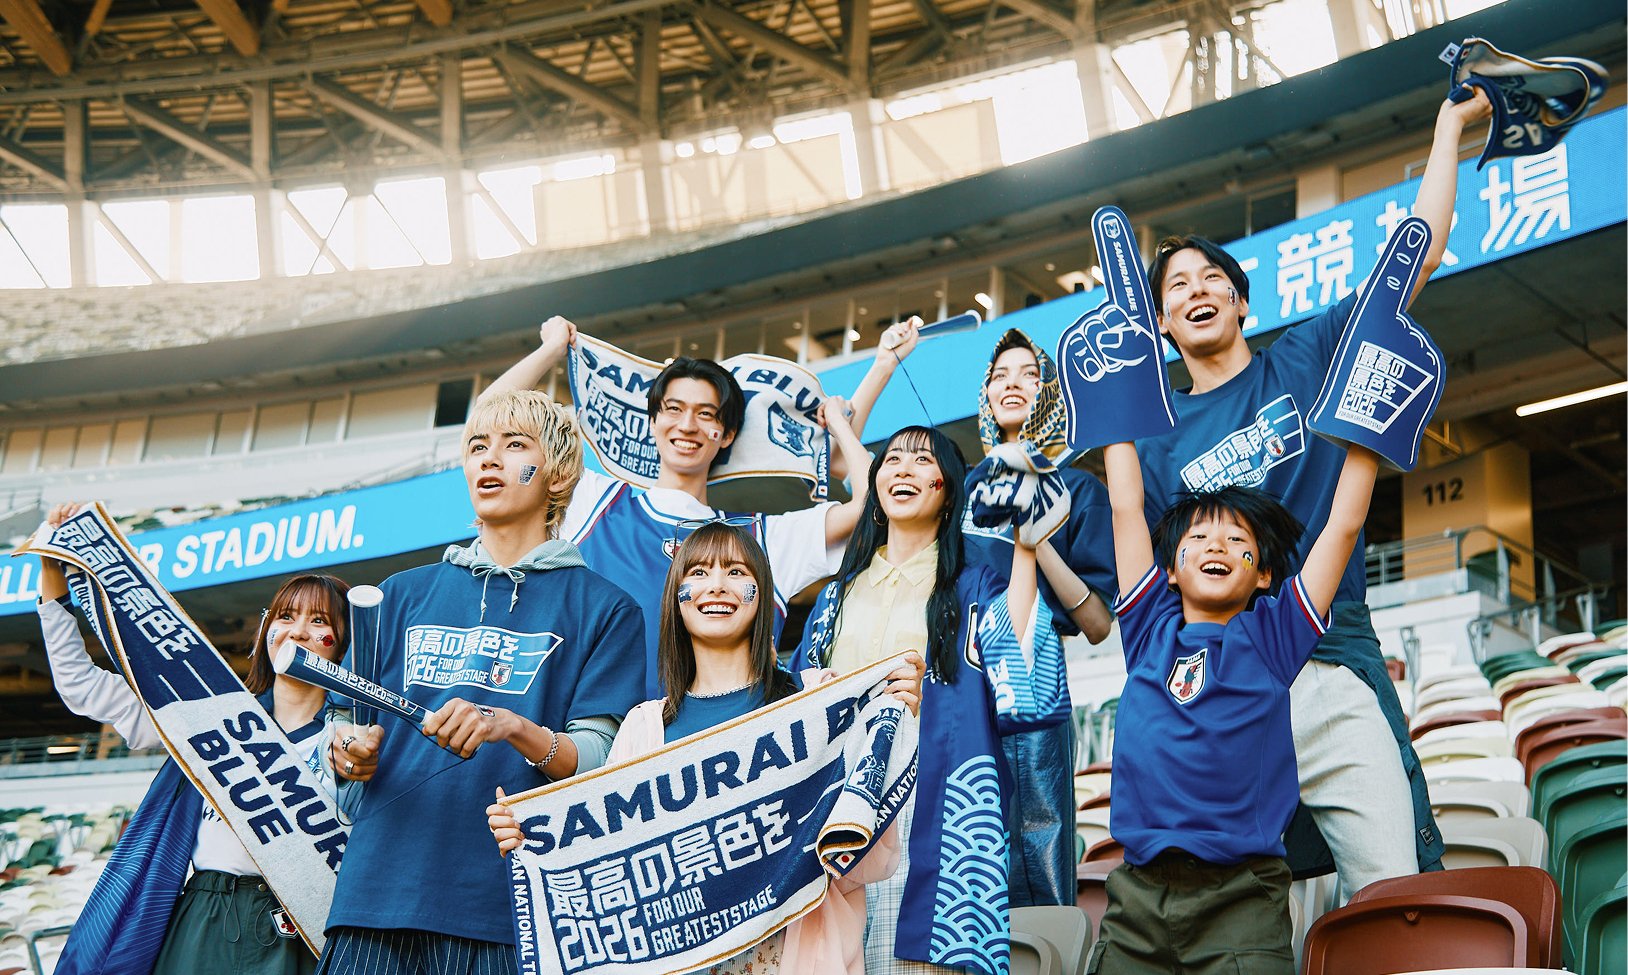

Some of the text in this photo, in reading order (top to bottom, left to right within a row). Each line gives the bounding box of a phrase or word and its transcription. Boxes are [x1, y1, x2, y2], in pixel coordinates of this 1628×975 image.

[1113, 241, 1138, 311] SAMURAI BLUE
[1350, 367, 1397, 400] 景色を
[1358, 345, 1406, 379] 最高の
[1342, 389, 1379, 417] 2026
[622, 439, 640, 455] FOR
[1185, 414, 1275, 489] 最高の景色を
[1423, 477, 1464, 506] 112
[172, 505, 364, 578] STADIUM.
[408, 629, 520, 662] 最高の景色を
[437, 657, 452, 670] FOR
[188, 729, 294, 846] BLUE
[520, 718, 809, 856] SAMURAI
[546, 798, 793, 918] 最高の景色を
[513, 884, 536, 961] NATIONAL
[556, 886, 706, 972] 2026 FOR OUR
